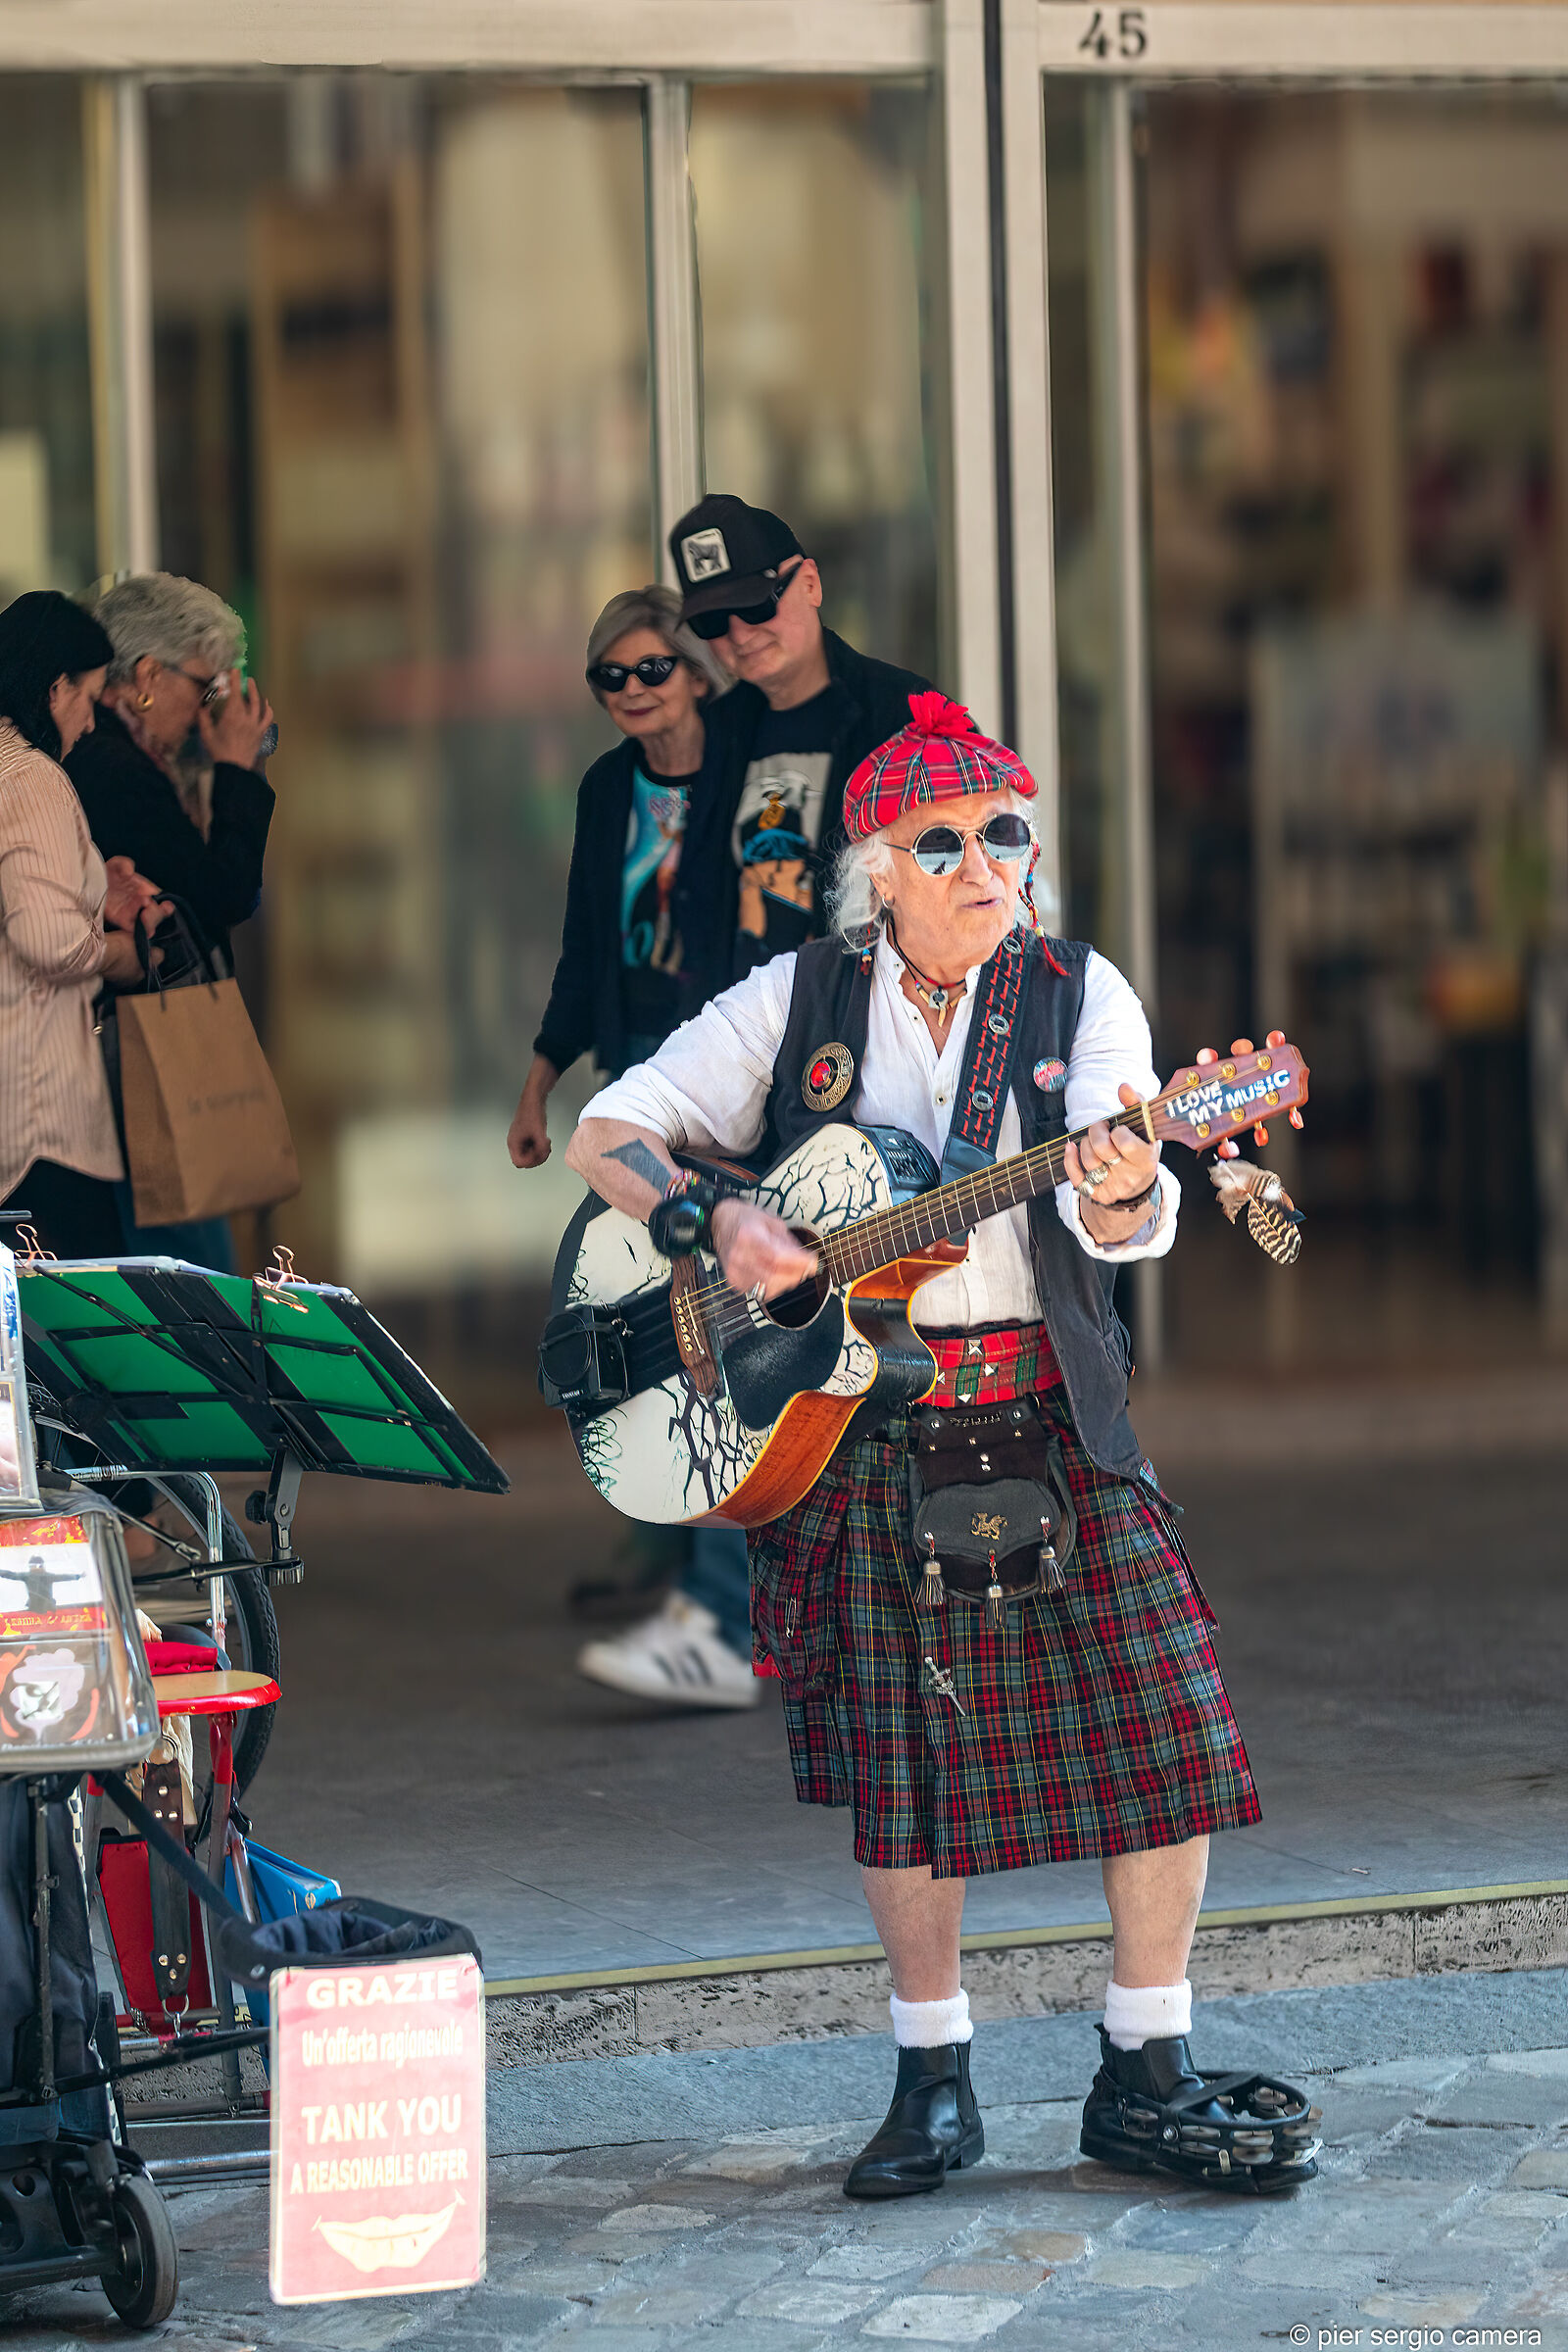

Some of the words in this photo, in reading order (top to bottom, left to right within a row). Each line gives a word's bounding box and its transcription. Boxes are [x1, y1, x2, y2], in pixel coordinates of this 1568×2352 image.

[1079, 10, 1147, 58] 45
[1166, 1101, 1176, 1118] I
[1176, 1080, 1223, 1110] LOVE
[1188, 1098, 1224, 1126] MY
[1225, 1069, 1292, 1109] MUSIC
[307, 1968, 459, 2009] GRAZIE
[302, 2025, 378, 2067] Un'offerta
[379, 2017, 464, 2069] ragionevole
[301, 2100, 389, 2144] TANK
[397, 2093, 462, 2136] YOU
[290, 2163, 304, 2194] A
[307, 2153, 414, 2193] REASONABLE
[417, 2148, 468, 2183] OFFER
